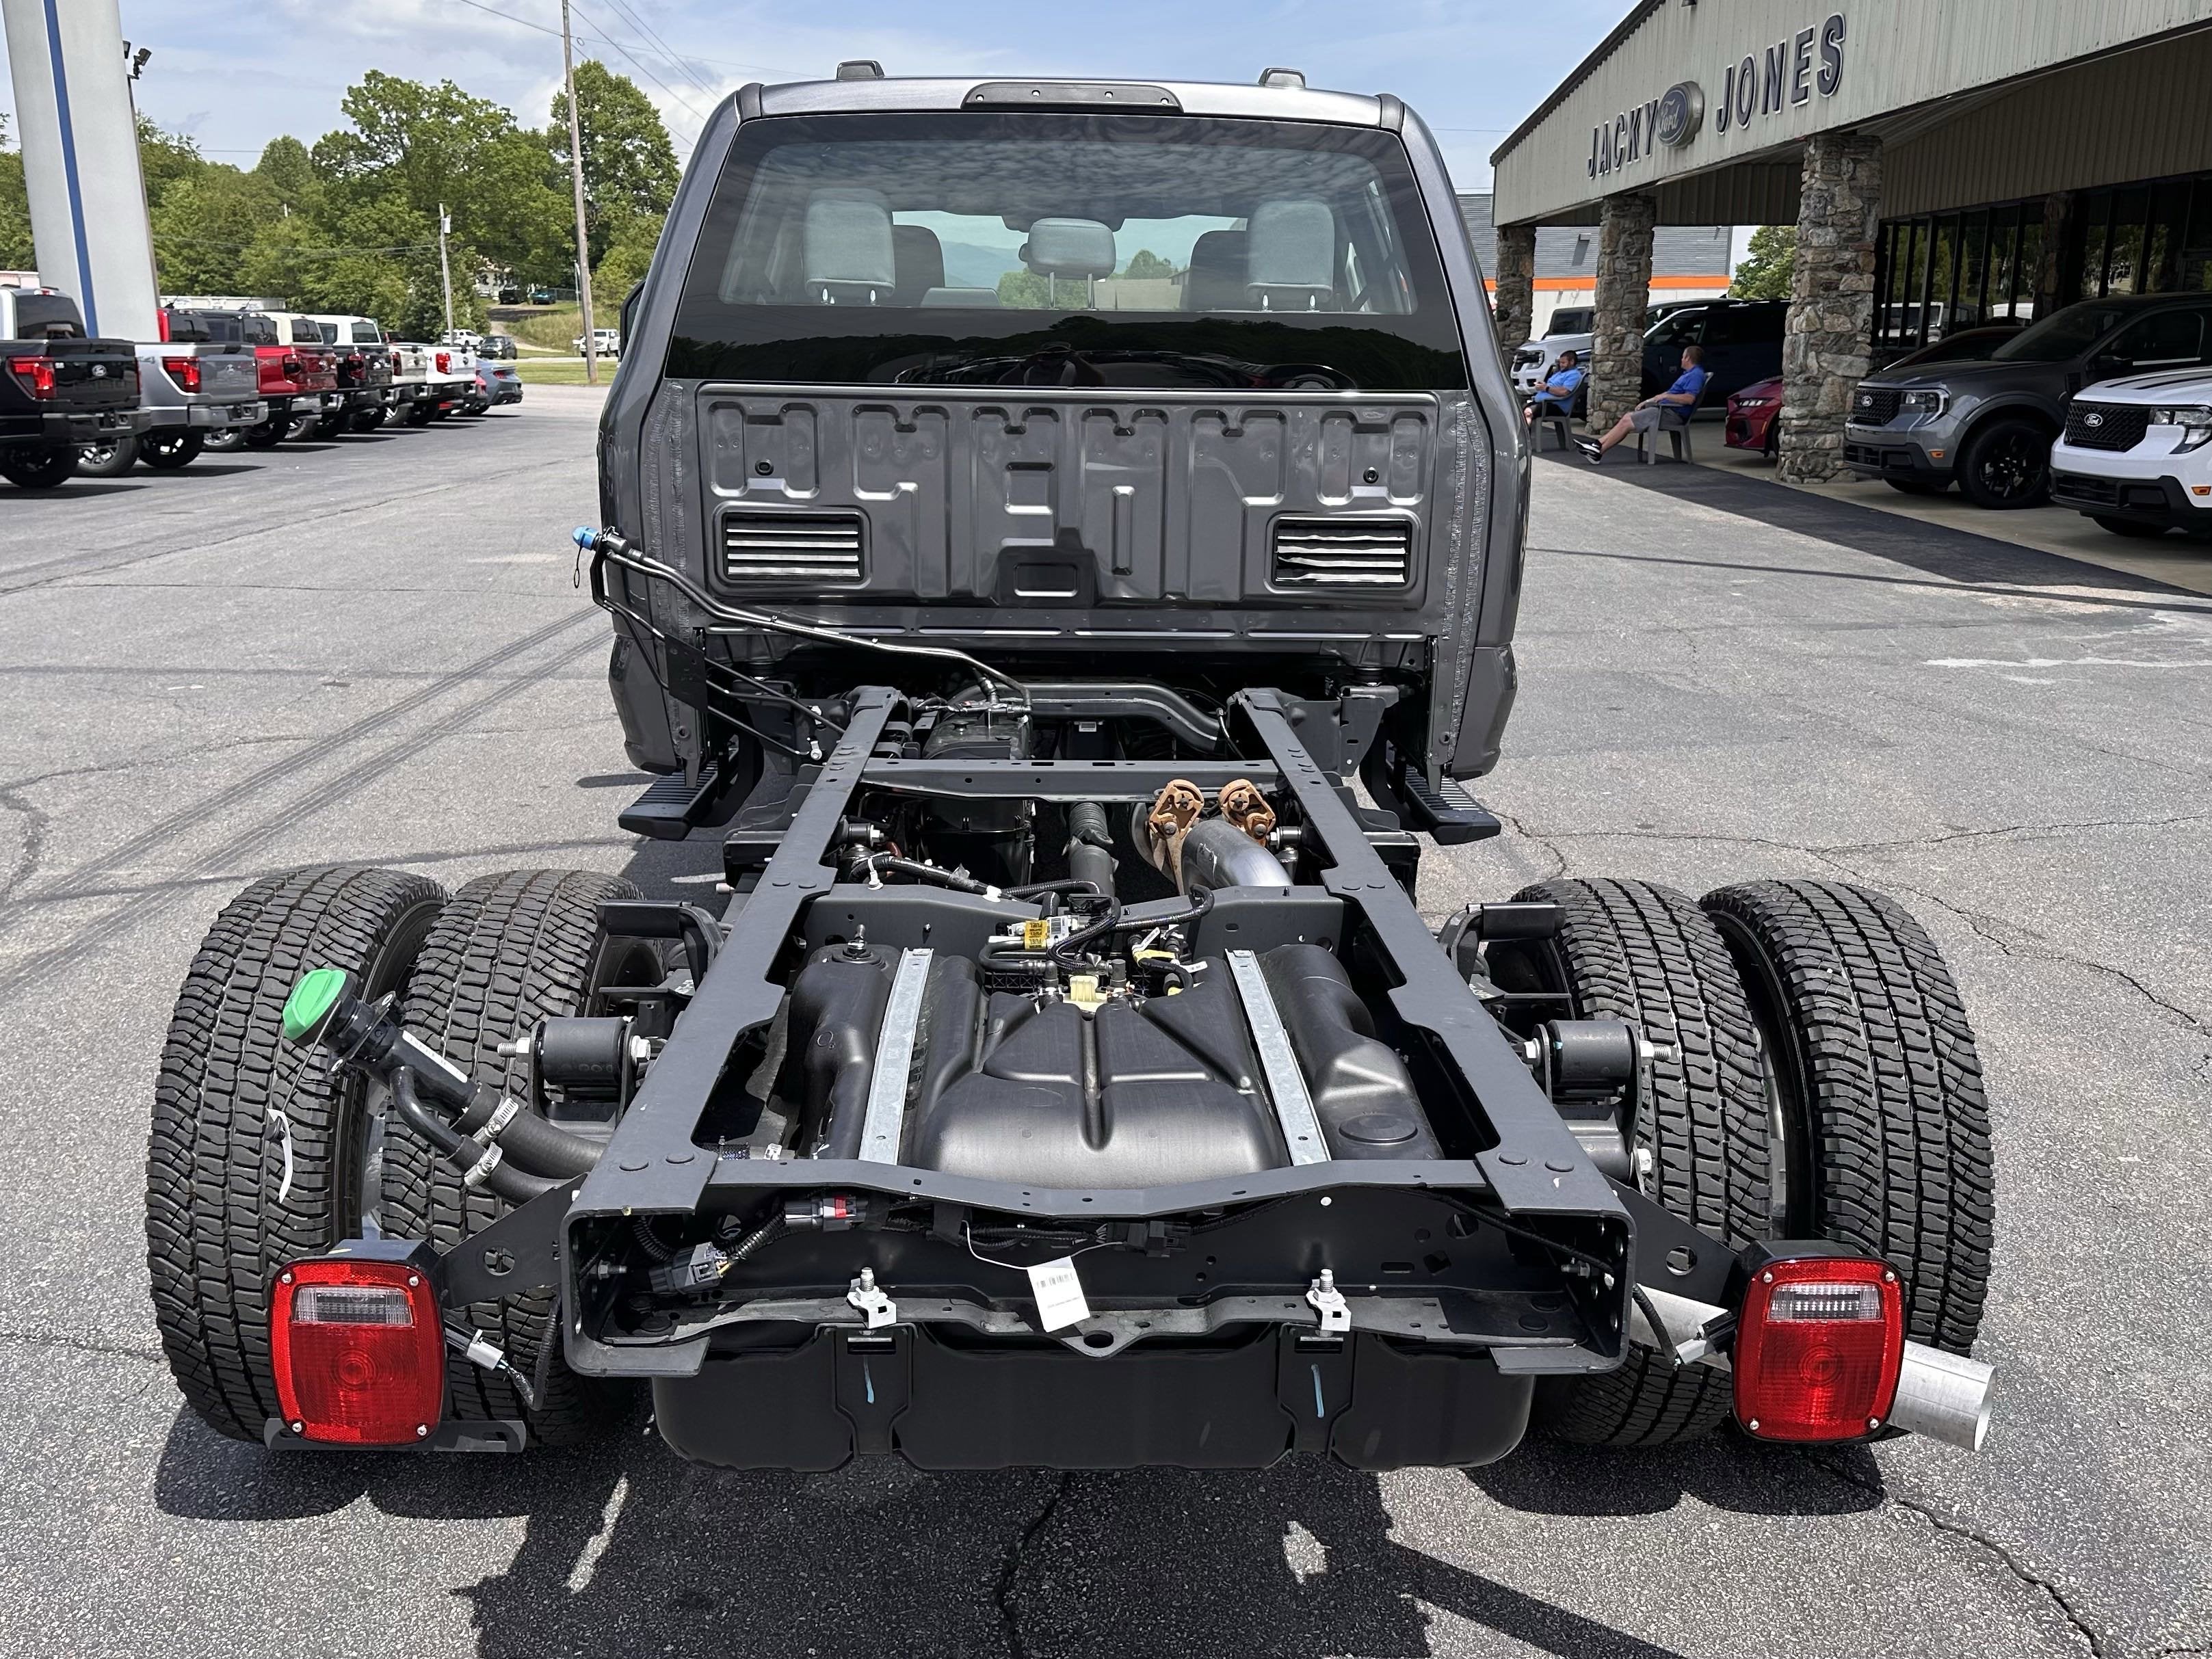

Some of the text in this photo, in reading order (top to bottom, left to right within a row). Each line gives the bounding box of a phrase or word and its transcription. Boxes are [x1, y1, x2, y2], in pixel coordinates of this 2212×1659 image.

[1588, 11, 1846, 179] JACKY Ford JONES
